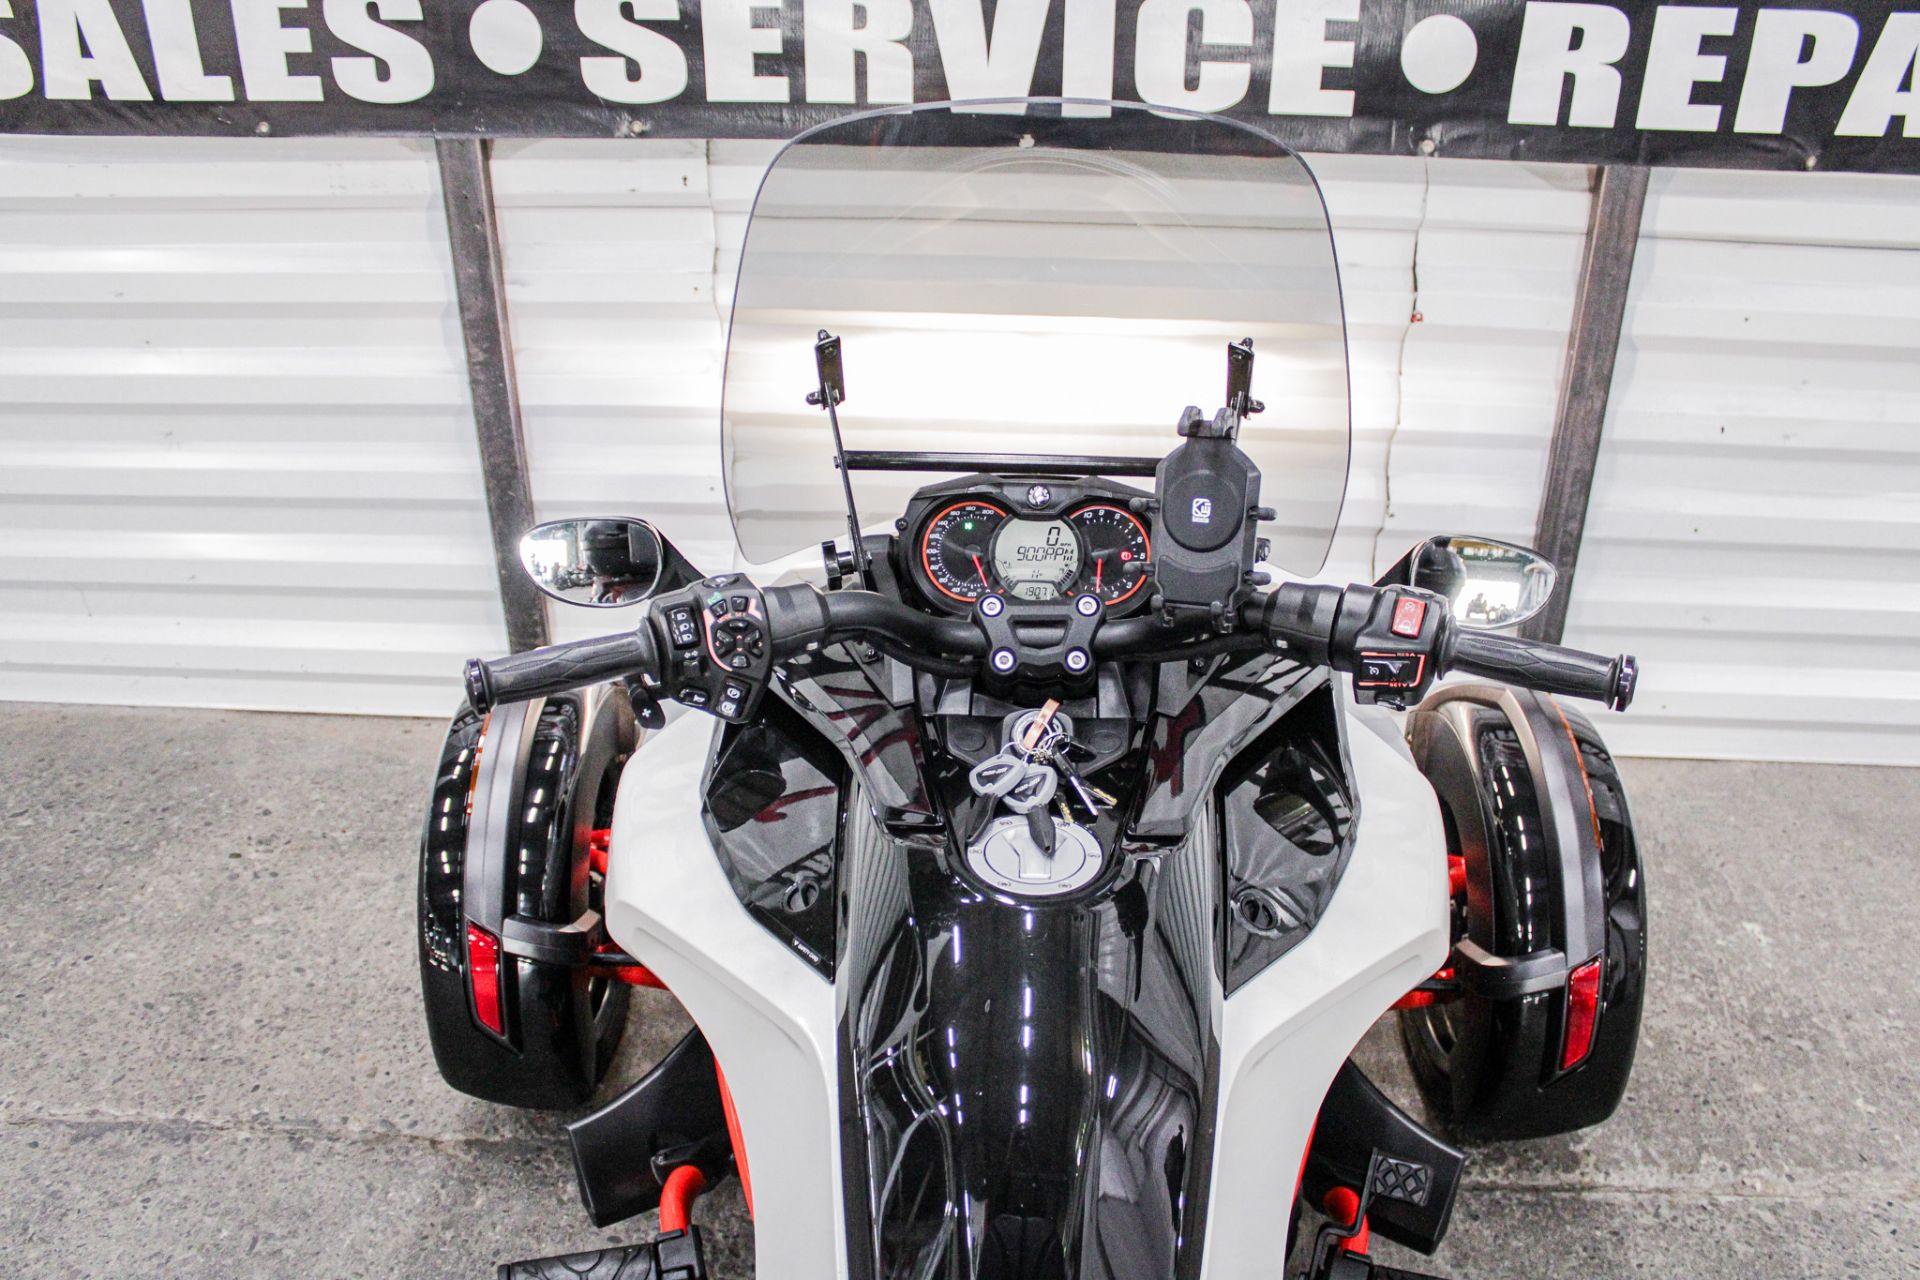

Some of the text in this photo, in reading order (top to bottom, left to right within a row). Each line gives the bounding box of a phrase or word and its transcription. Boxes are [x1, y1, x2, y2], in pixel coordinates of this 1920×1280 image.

[574, 0, 1360, 119] SERVICE
[1083, 511, 1093, 519] 10
[964, 522, 973, 530] N
[1046, 526, 1061, 546] 0
[1139, 552, 1146, 560] 5
[1126, 581, 1133, 589] 3
